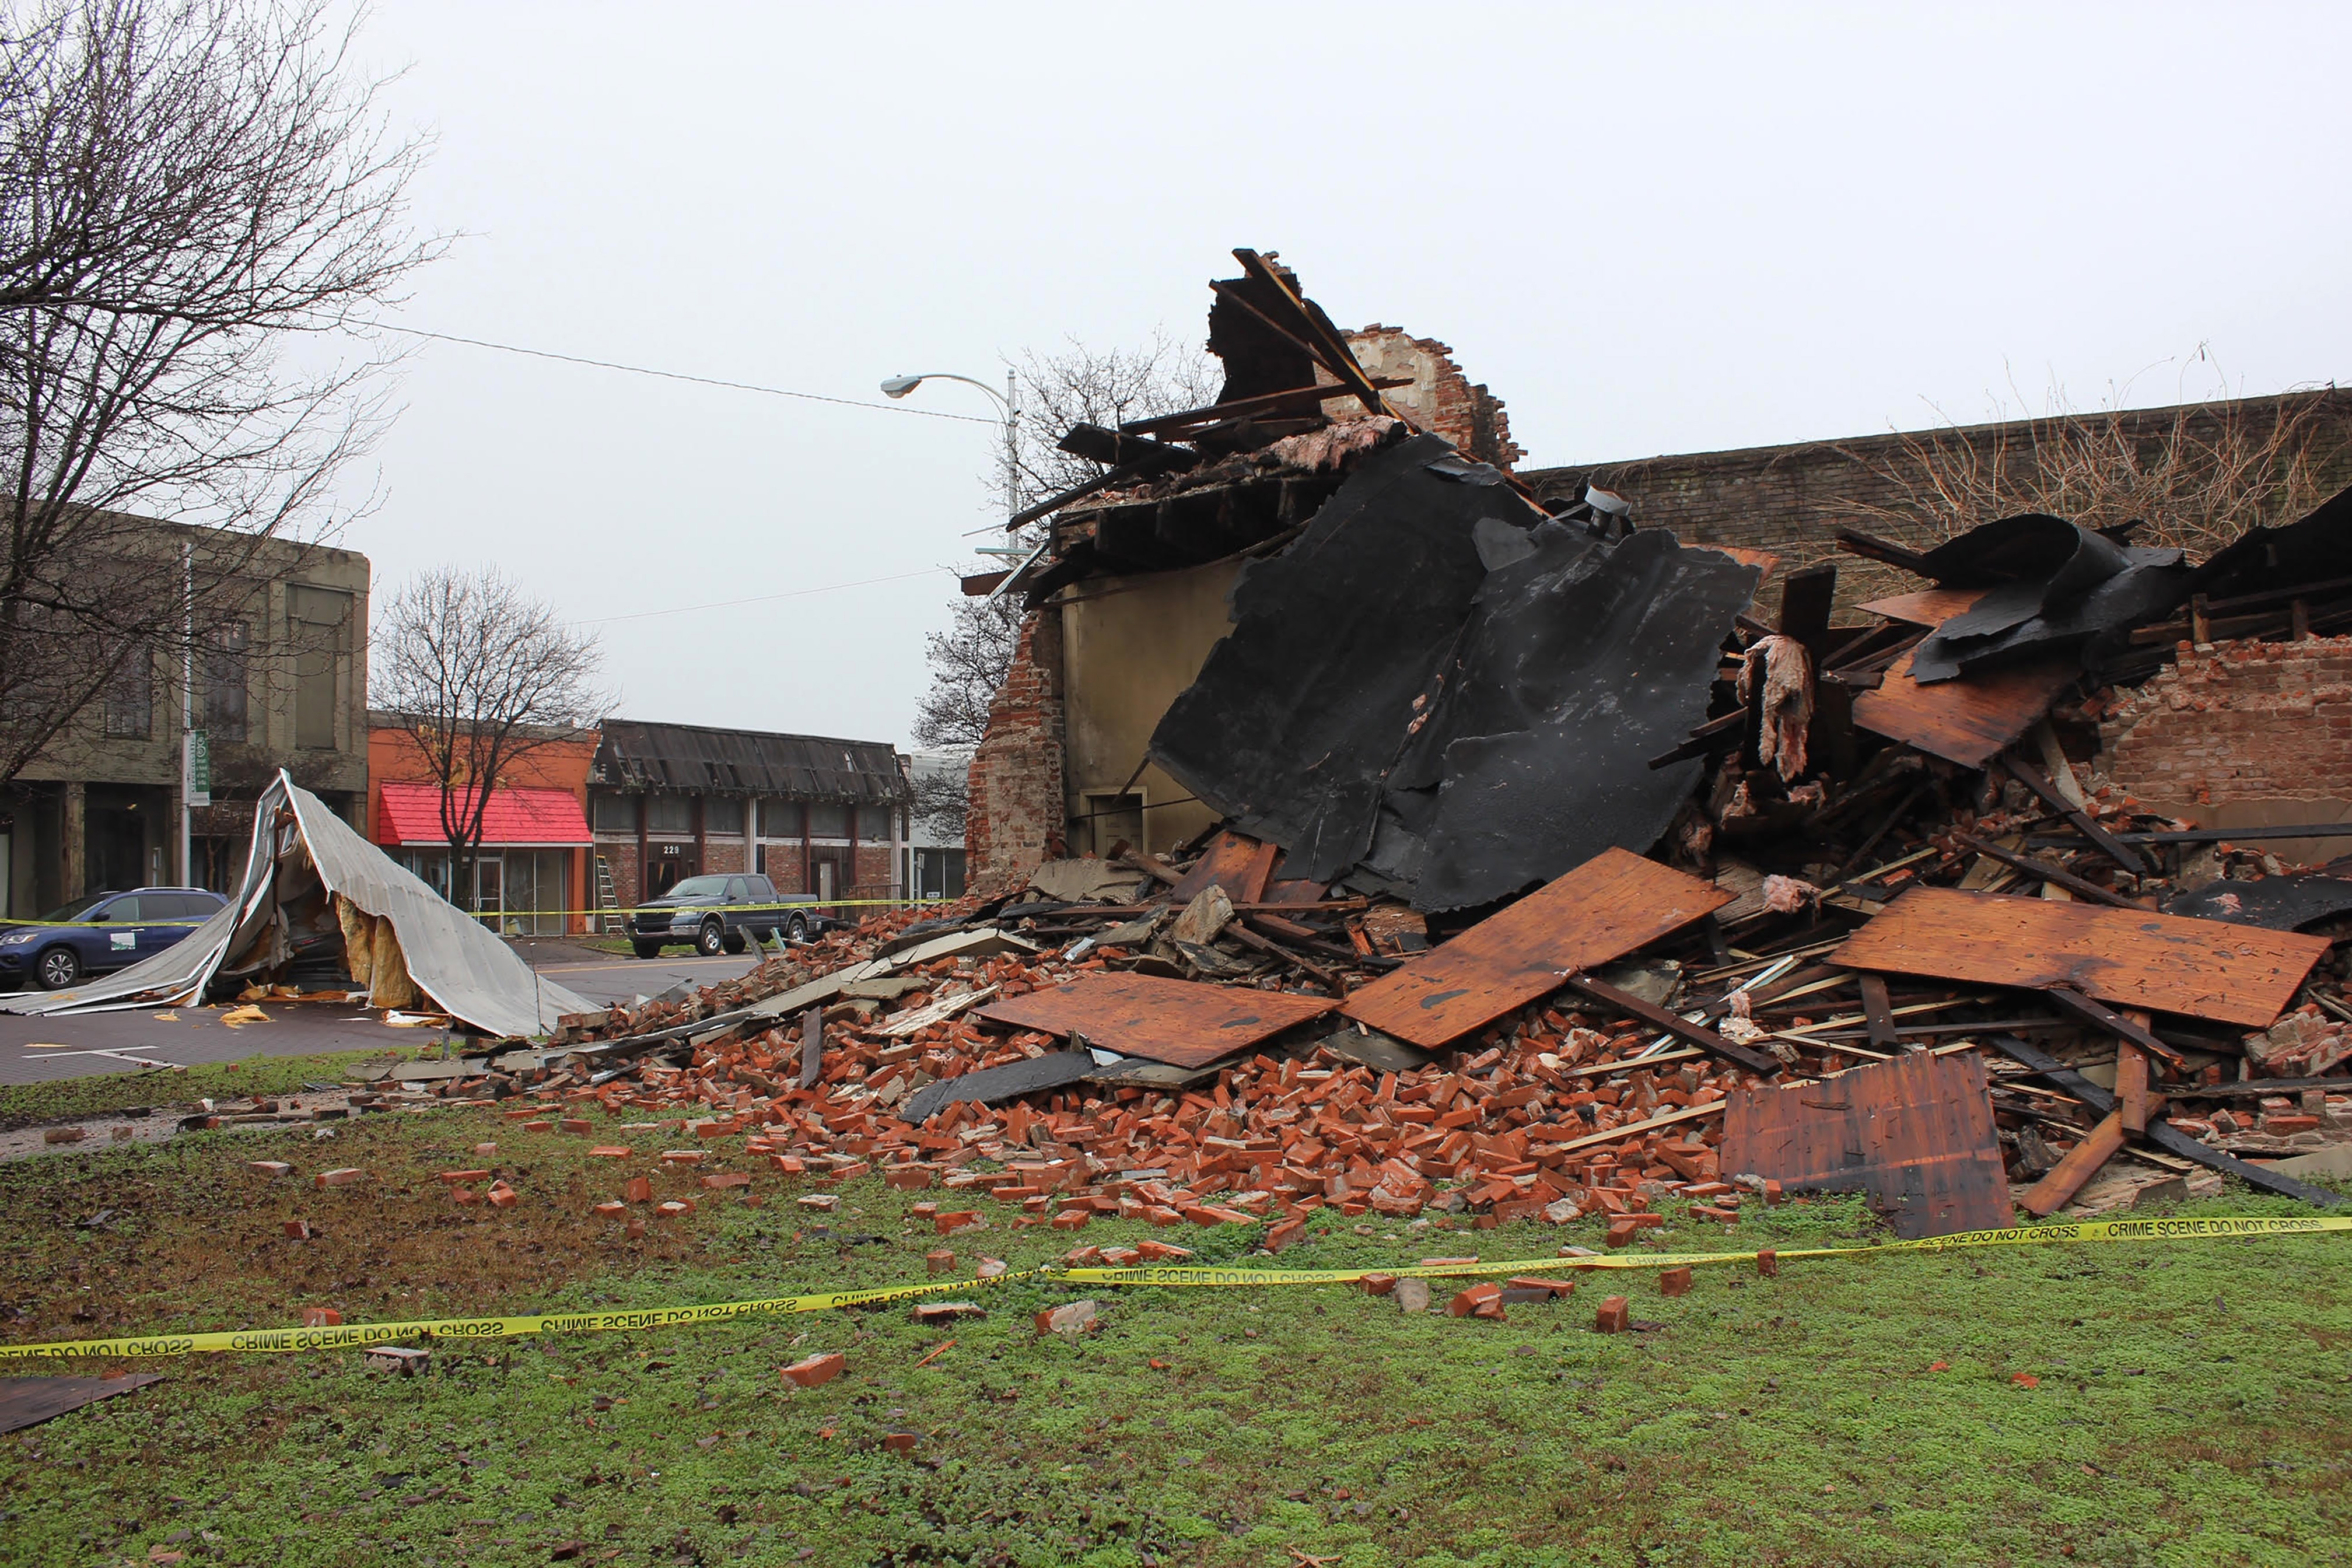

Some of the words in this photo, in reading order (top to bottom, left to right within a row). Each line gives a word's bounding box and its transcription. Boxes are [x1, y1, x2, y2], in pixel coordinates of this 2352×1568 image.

[663, 846, 679, 854] 229
[1971, 1229, 1993, 1242] DO
[1996, 1228, 2026, 1241] NOT
[2028, 1226, 2080, 1239] CROSS
[2108, 1222, 2154, 1237] CRIME
[2158, 1220, 2207, 1236] SCENE
[2210, 1220, 2232, 1233] DO
[2235, 1220, 2264, 1233] NOT
[2268, 1219, 2323, 1231] CROSS
